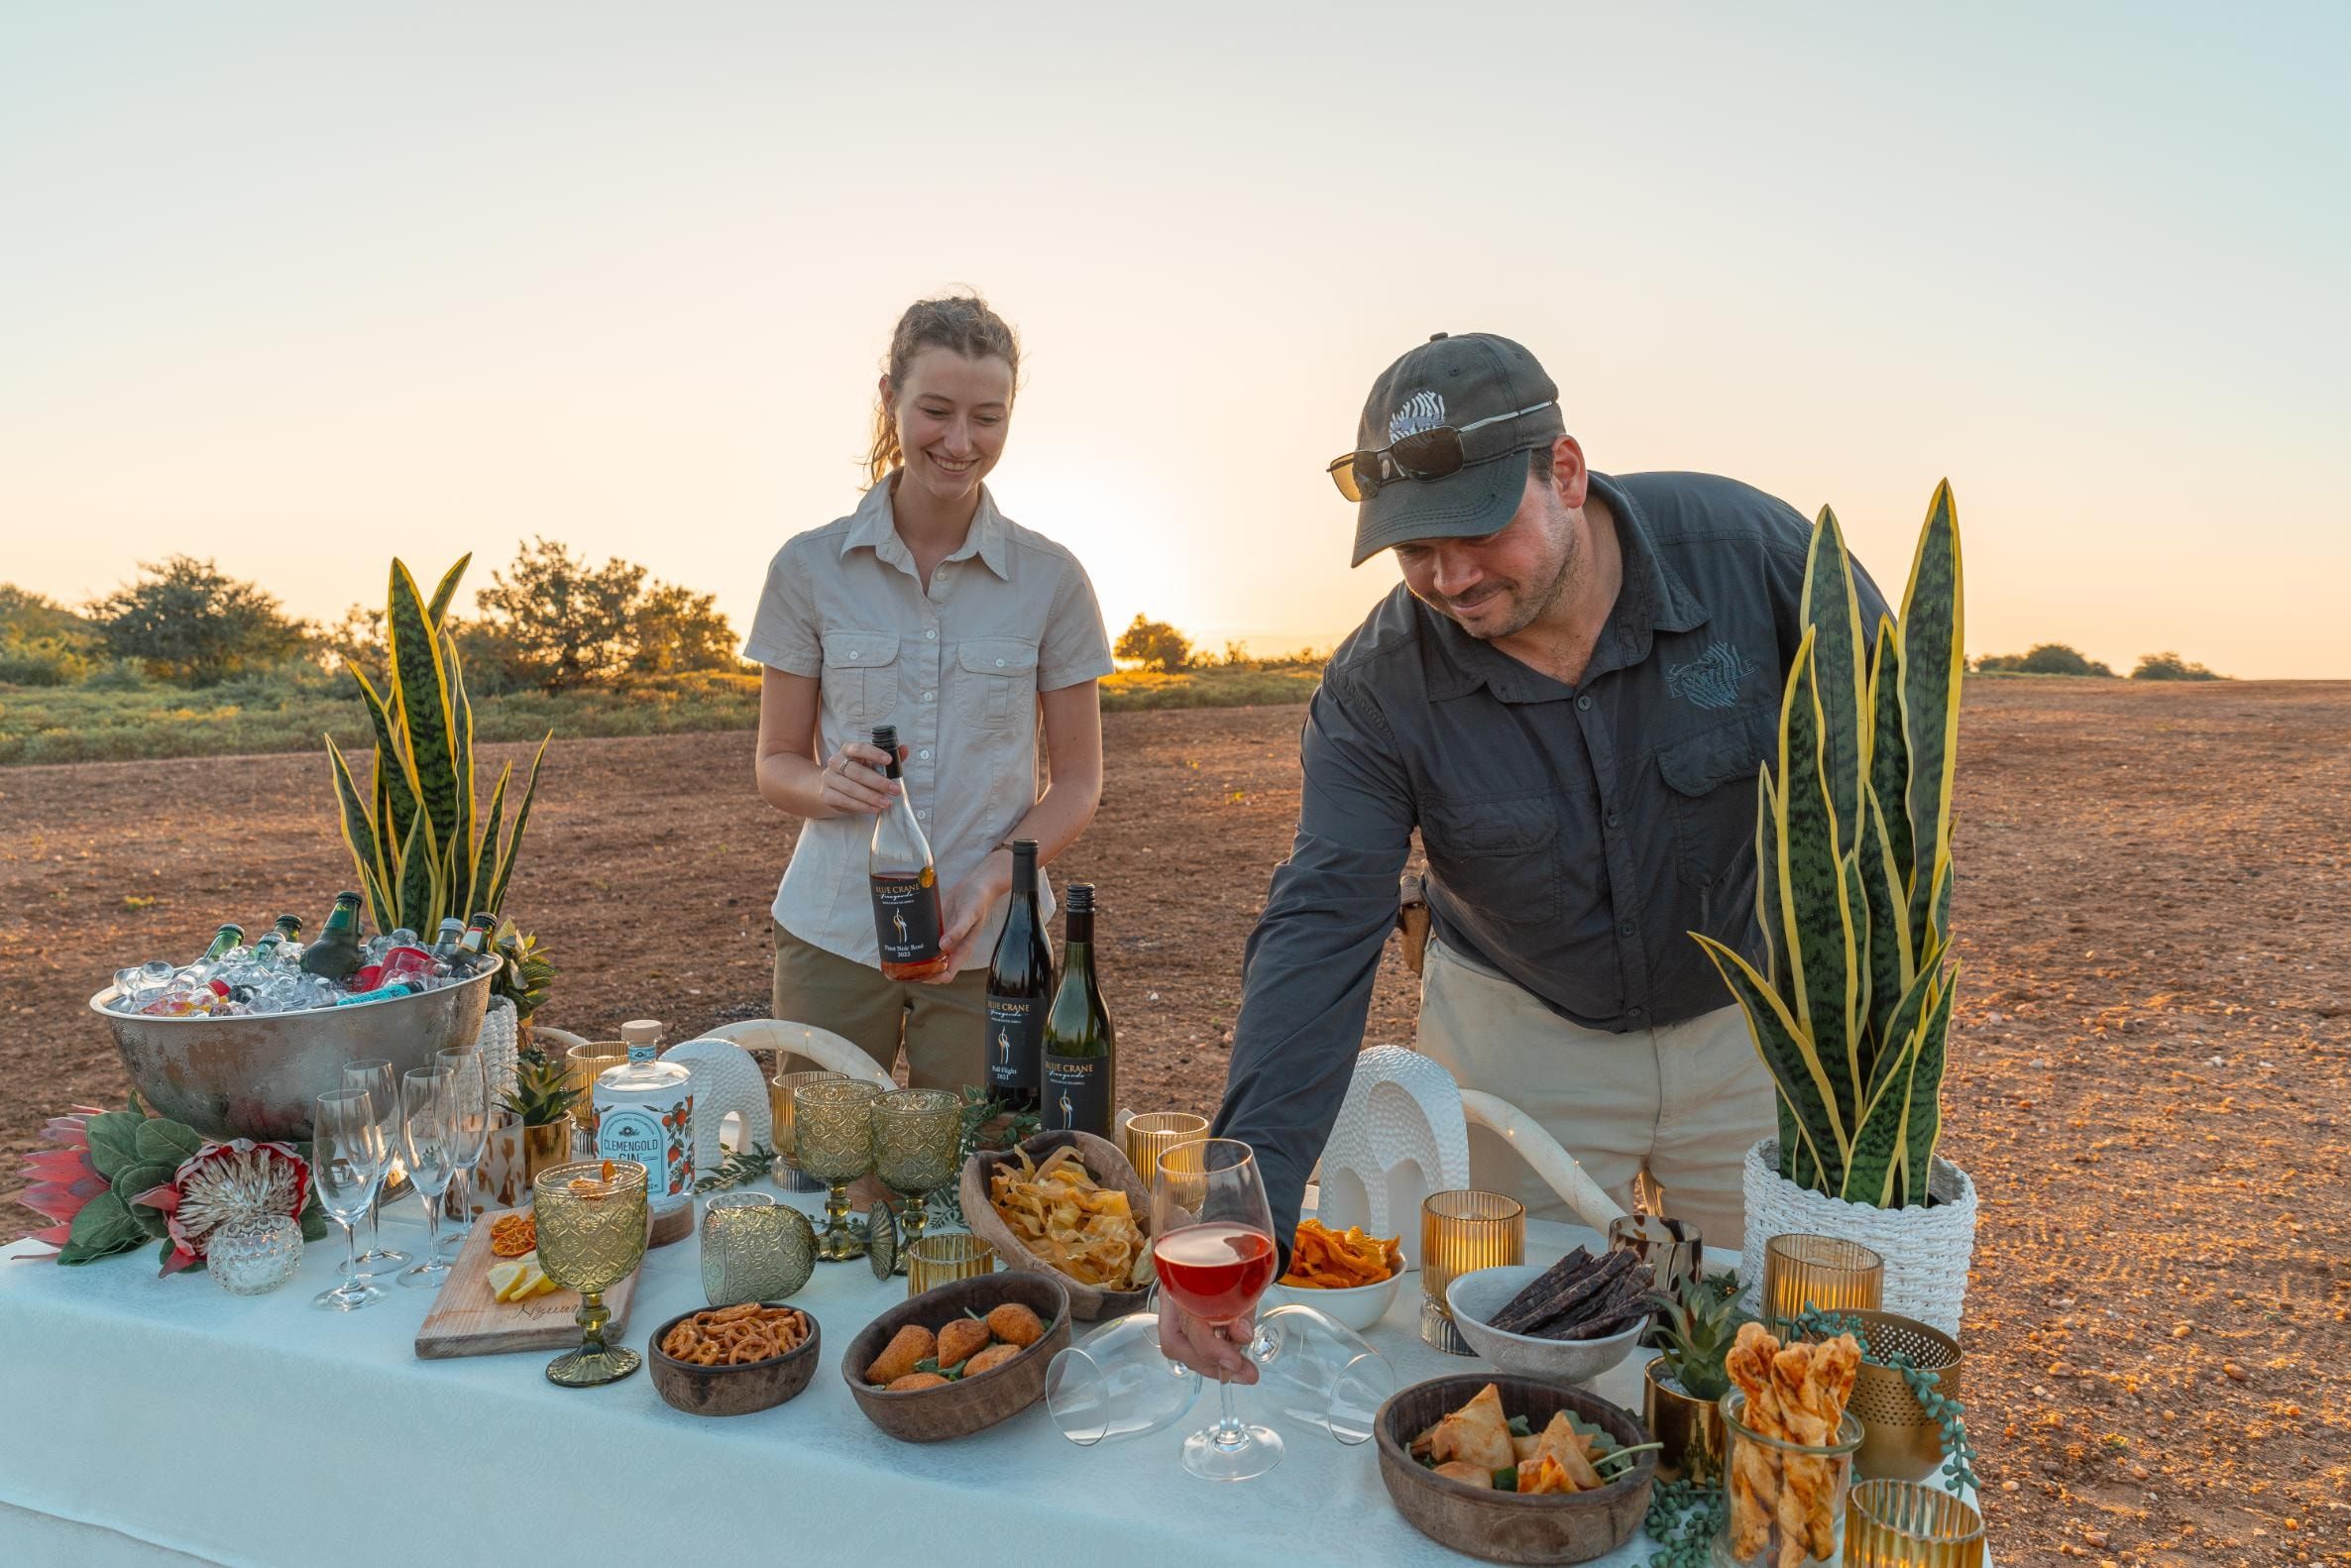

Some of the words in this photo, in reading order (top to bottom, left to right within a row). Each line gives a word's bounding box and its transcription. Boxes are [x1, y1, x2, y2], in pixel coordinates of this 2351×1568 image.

[892, 883, 920, 893] CRANE
[1001, 1003, 1031, 1012] CRANE
[1063, 1064, 1094, 1072] CRANE
[604, 1139, 658, 1152] CLEMENGOLD
[618, 1153, 640, 1163] GIN
